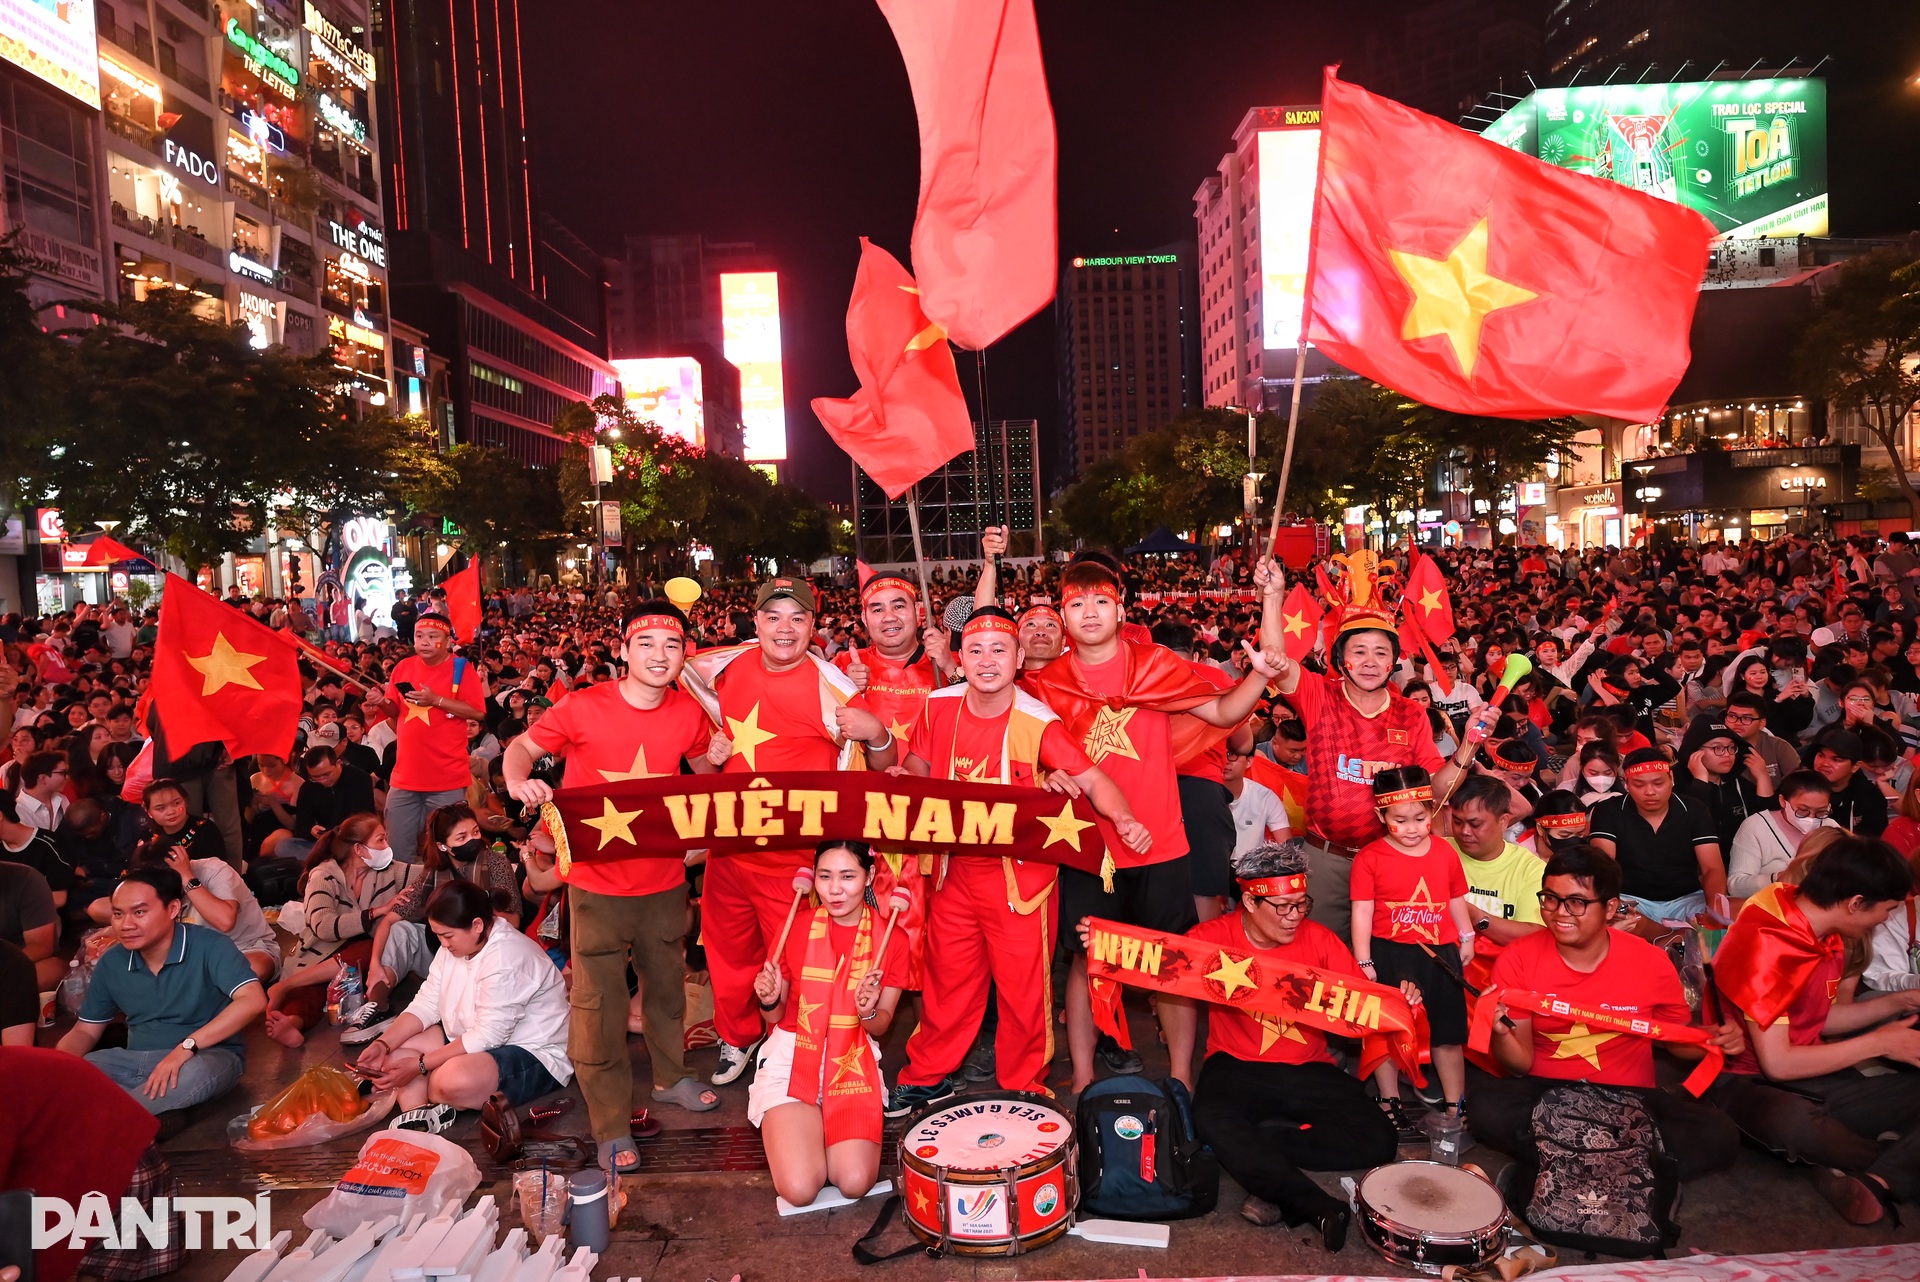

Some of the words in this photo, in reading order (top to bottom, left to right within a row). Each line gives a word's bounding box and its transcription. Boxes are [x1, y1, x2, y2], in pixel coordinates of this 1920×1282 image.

[244, 54, 262, 78] THE
[262, 70, 296, 101] LETTER
[1712, 104, 1739, 116] TRAO
[1764, 101, 1807, 114] SPECIAL
[1286, 110, 1319, 124] SAIGON
[165, 138, 218, 184] FADO
[330, 220, 358, 254] THE
[359, 238, 386, 268] ONE
[1084, 257, 1122, 266] HARBOUR
[1147, 255, 1176, 263] TOWER
[1781, 477, 1826, 489] CHUA
[632, 619, 648, 630] NAM
[995, 622, 1013, 631] ĐỊCH
[955, 756, 973, 769] NAM
[1393, 792, 1409, 801] NAM
[663, 777, 838, 846] VIỆT
[863, 791, 1017, 845] NAM
[1470, 886, 1498, 897] Annual
[1416, 909, 1442, 924] Nam
[1094, 930, 1163, 976] NAM
[1304, 980, 1382, 1030] VIỆT
[1570, 1007, 1581, 1016] VIỆT
[1582, 1010, 1594, 1019] NAM
[828, 1086, 873, 1097] SUPPORTERS
[930, 1104, 1002, 1128] GAMES
[1008, 1106, 1045, 1121] SEA
[918, 1129, 939, 1142] 31
